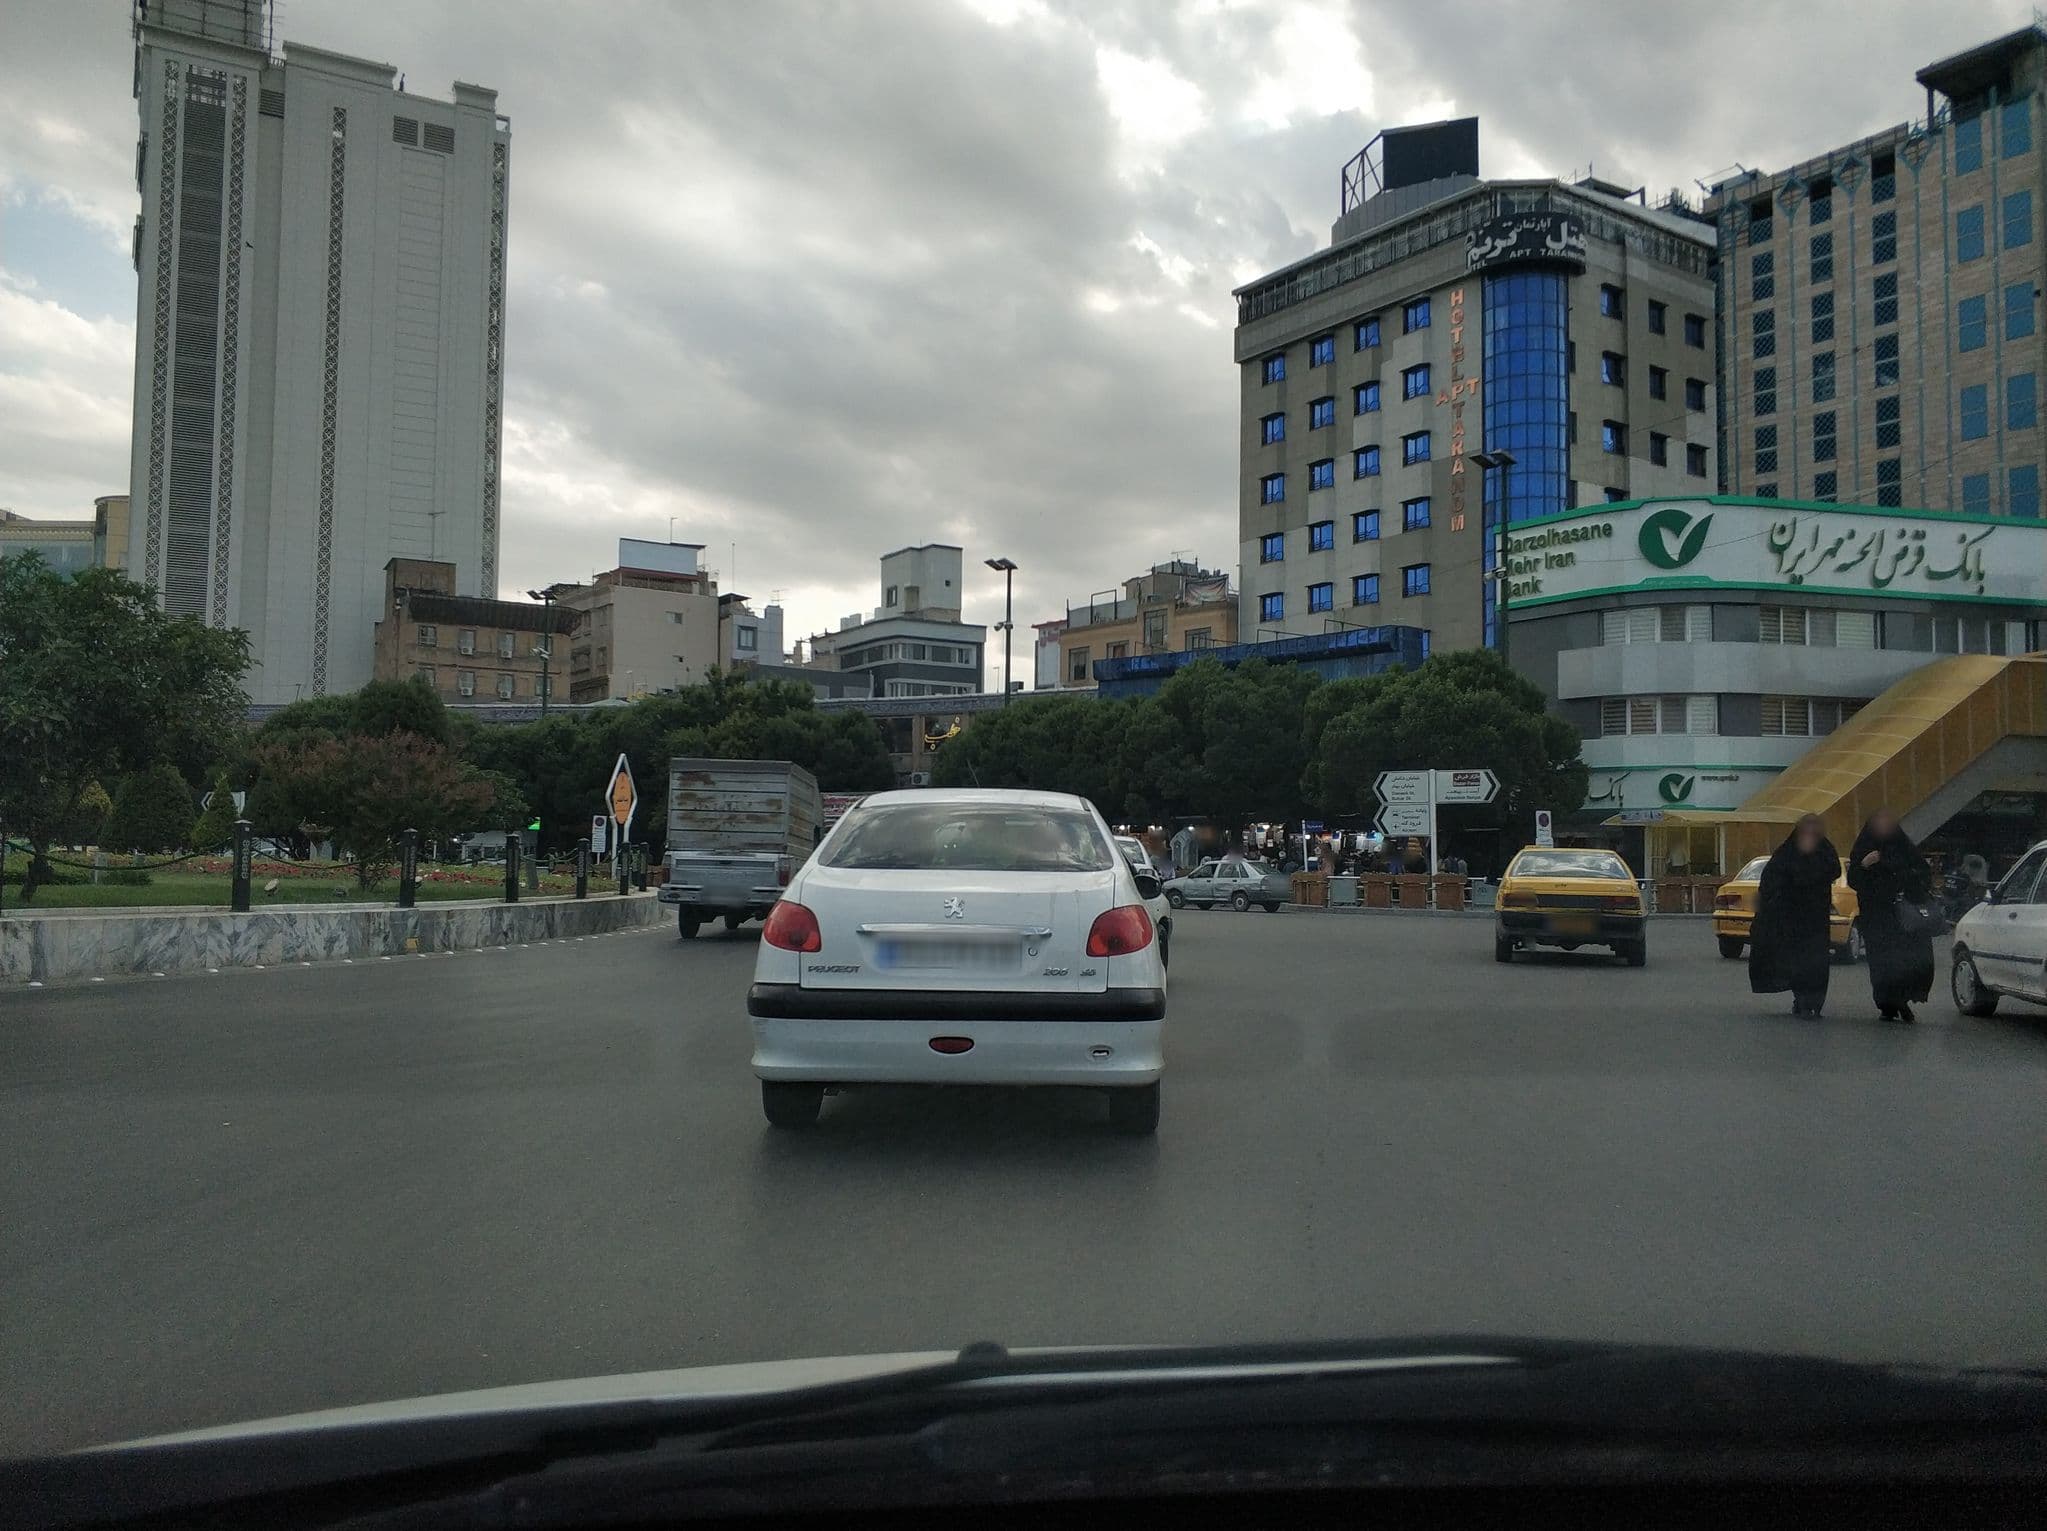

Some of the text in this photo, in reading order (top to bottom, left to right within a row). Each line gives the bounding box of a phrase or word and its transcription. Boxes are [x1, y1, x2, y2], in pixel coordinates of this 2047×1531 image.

[1546, 221, 1588, 250] هتل
[1509, 248, 1532, 259] APT
[1450, 288, 1465, 382] HOTEL
[1544, 551, 1575, 570] Iran
[1768, 516, 1820, 585] ایران
[1804, 536, 1845, 576] مهر
[1925, 525, 1996, 595] بانک
[1589, 771, 1632, 809] بانک
[808, 965, 861, 973] PEUGEOT
[1043, 968, 1069, 977] 206
